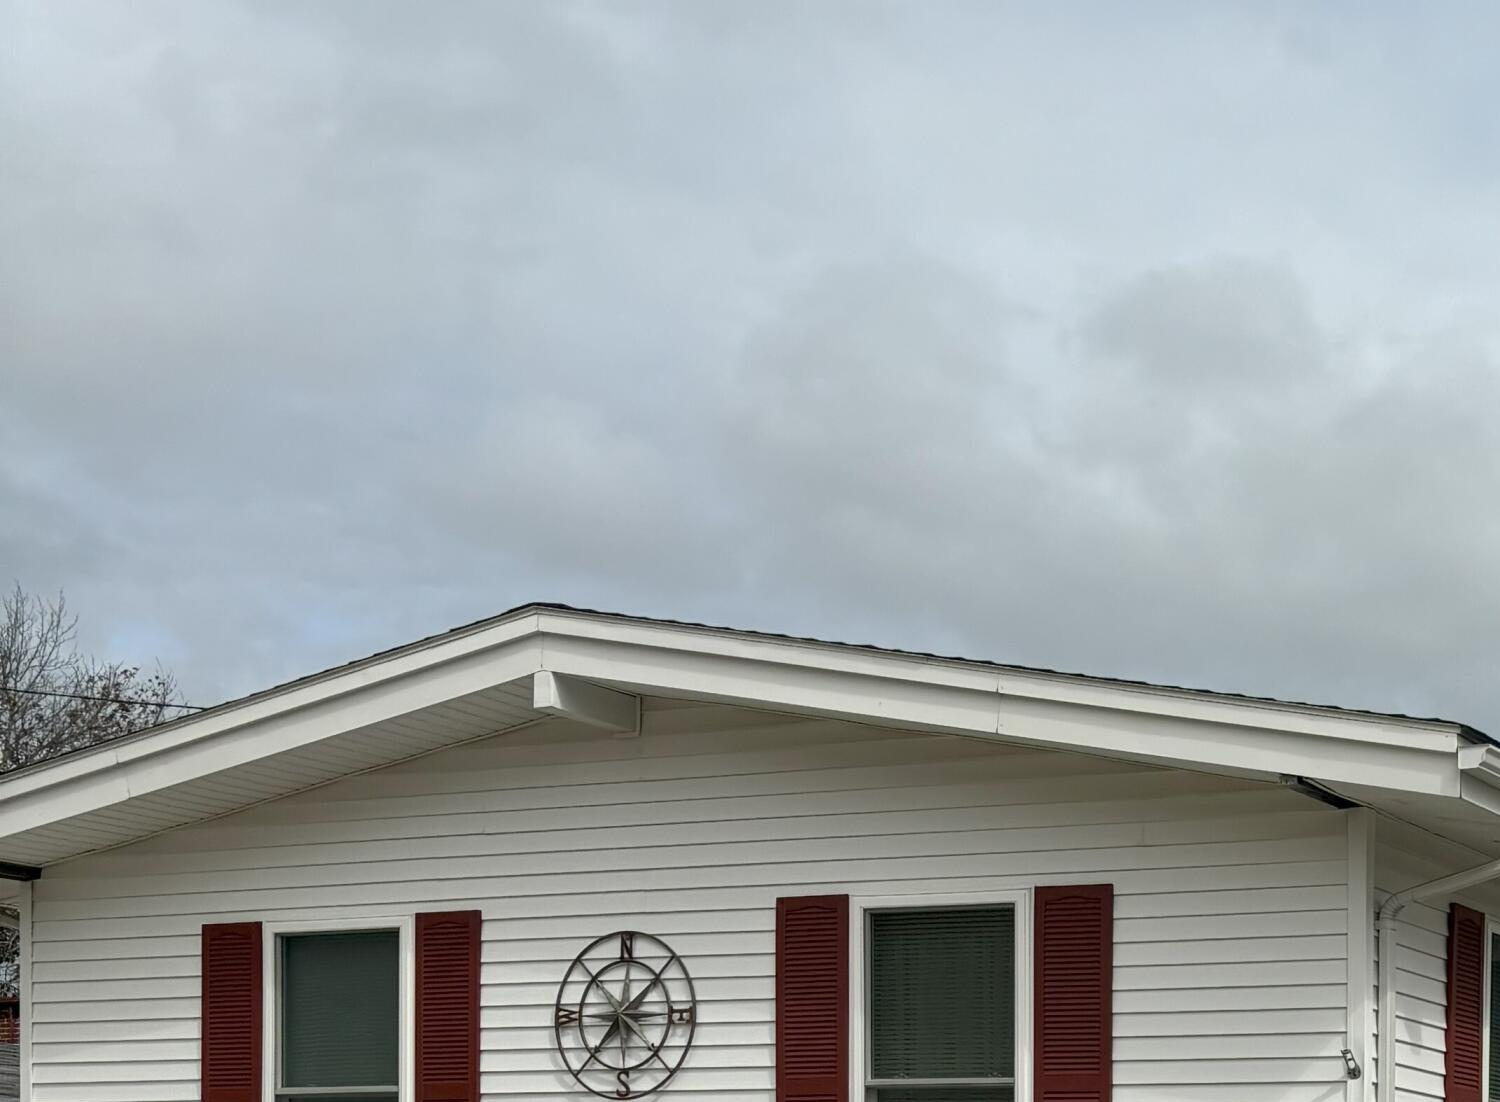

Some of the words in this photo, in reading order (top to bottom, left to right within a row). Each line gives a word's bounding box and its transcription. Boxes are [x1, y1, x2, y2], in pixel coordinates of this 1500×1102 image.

[620, 932, 634, 960] N
[557, 1007, 580, 1027] W
[668, 1005, 693, 1025] E
[616, 1070, 631, 1098] S
